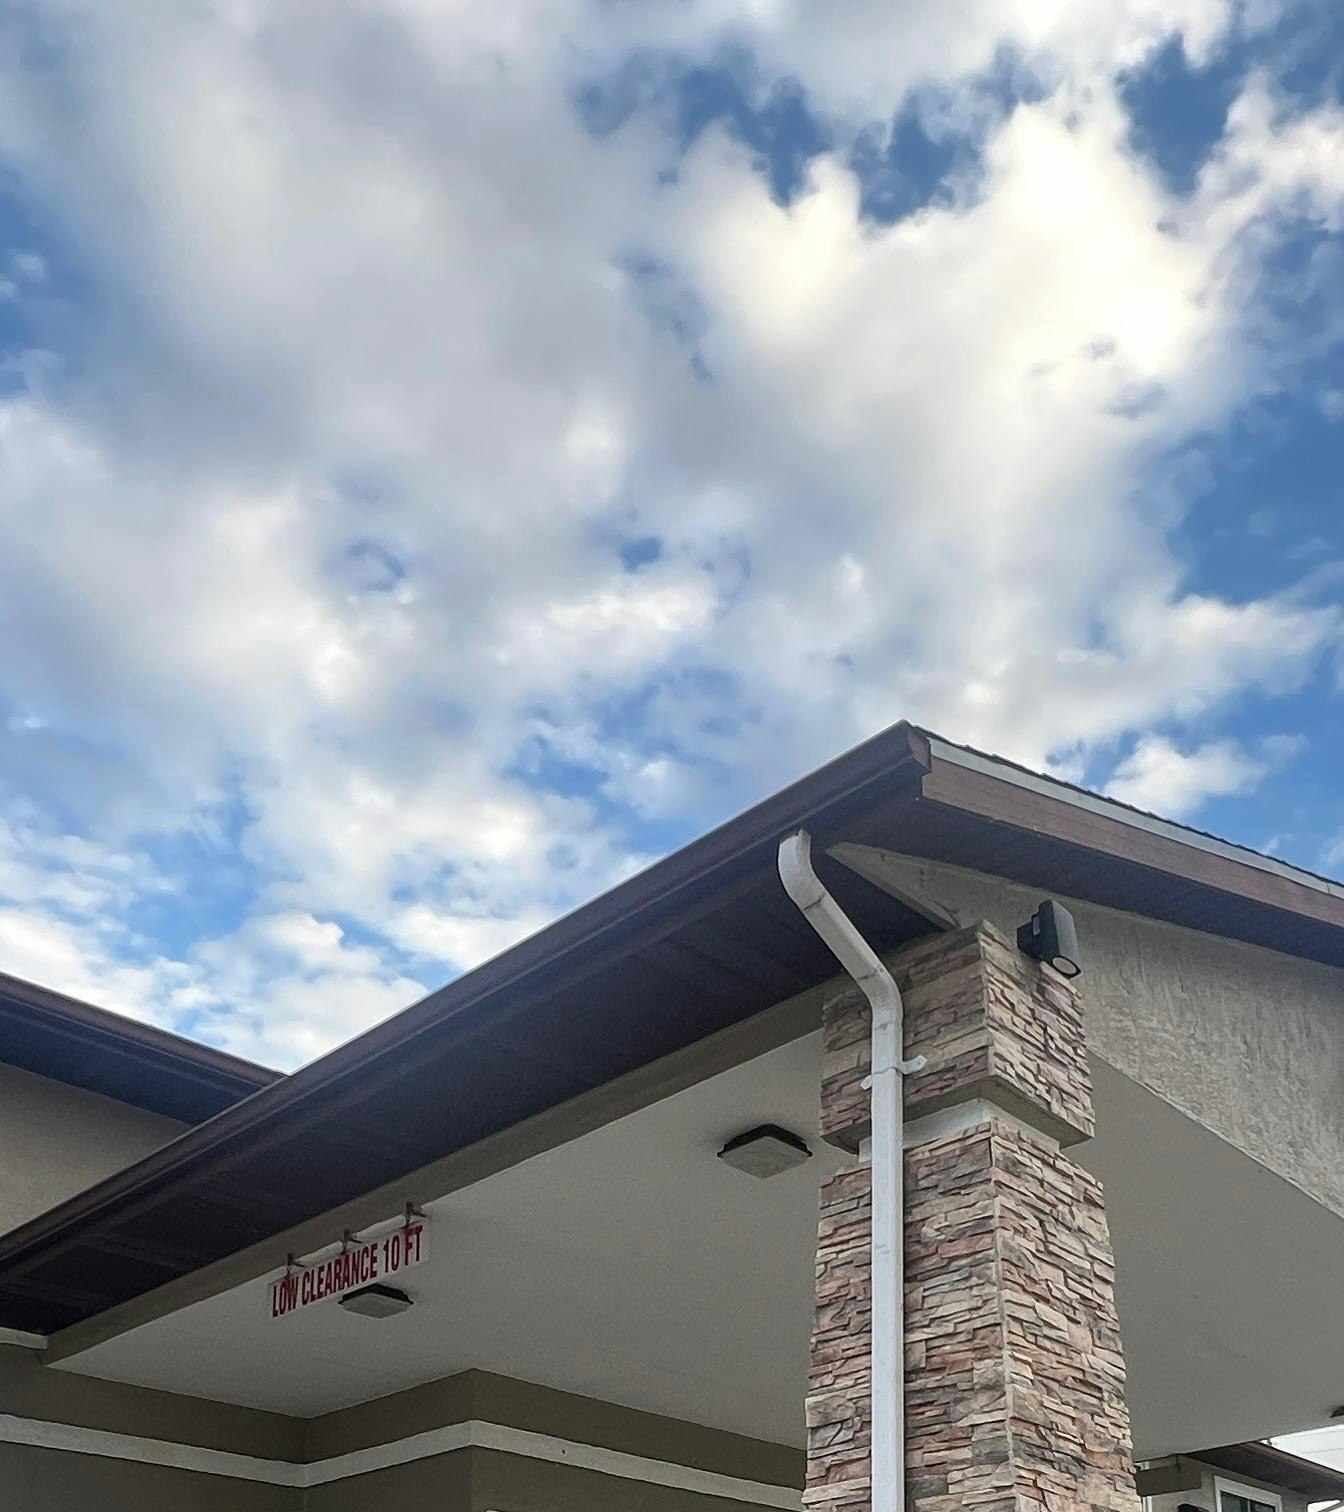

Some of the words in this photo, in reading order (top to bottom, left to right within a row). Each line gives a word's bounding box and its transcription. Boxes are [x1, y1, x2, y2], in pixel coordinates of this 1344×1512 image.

[272, 1274, 299, 1318] LOW
[301, 1243, 378, 1306] CLEARANCE
[384, 1235, 400, 1273] 10
[405, 1225, 424, 1266] FT
